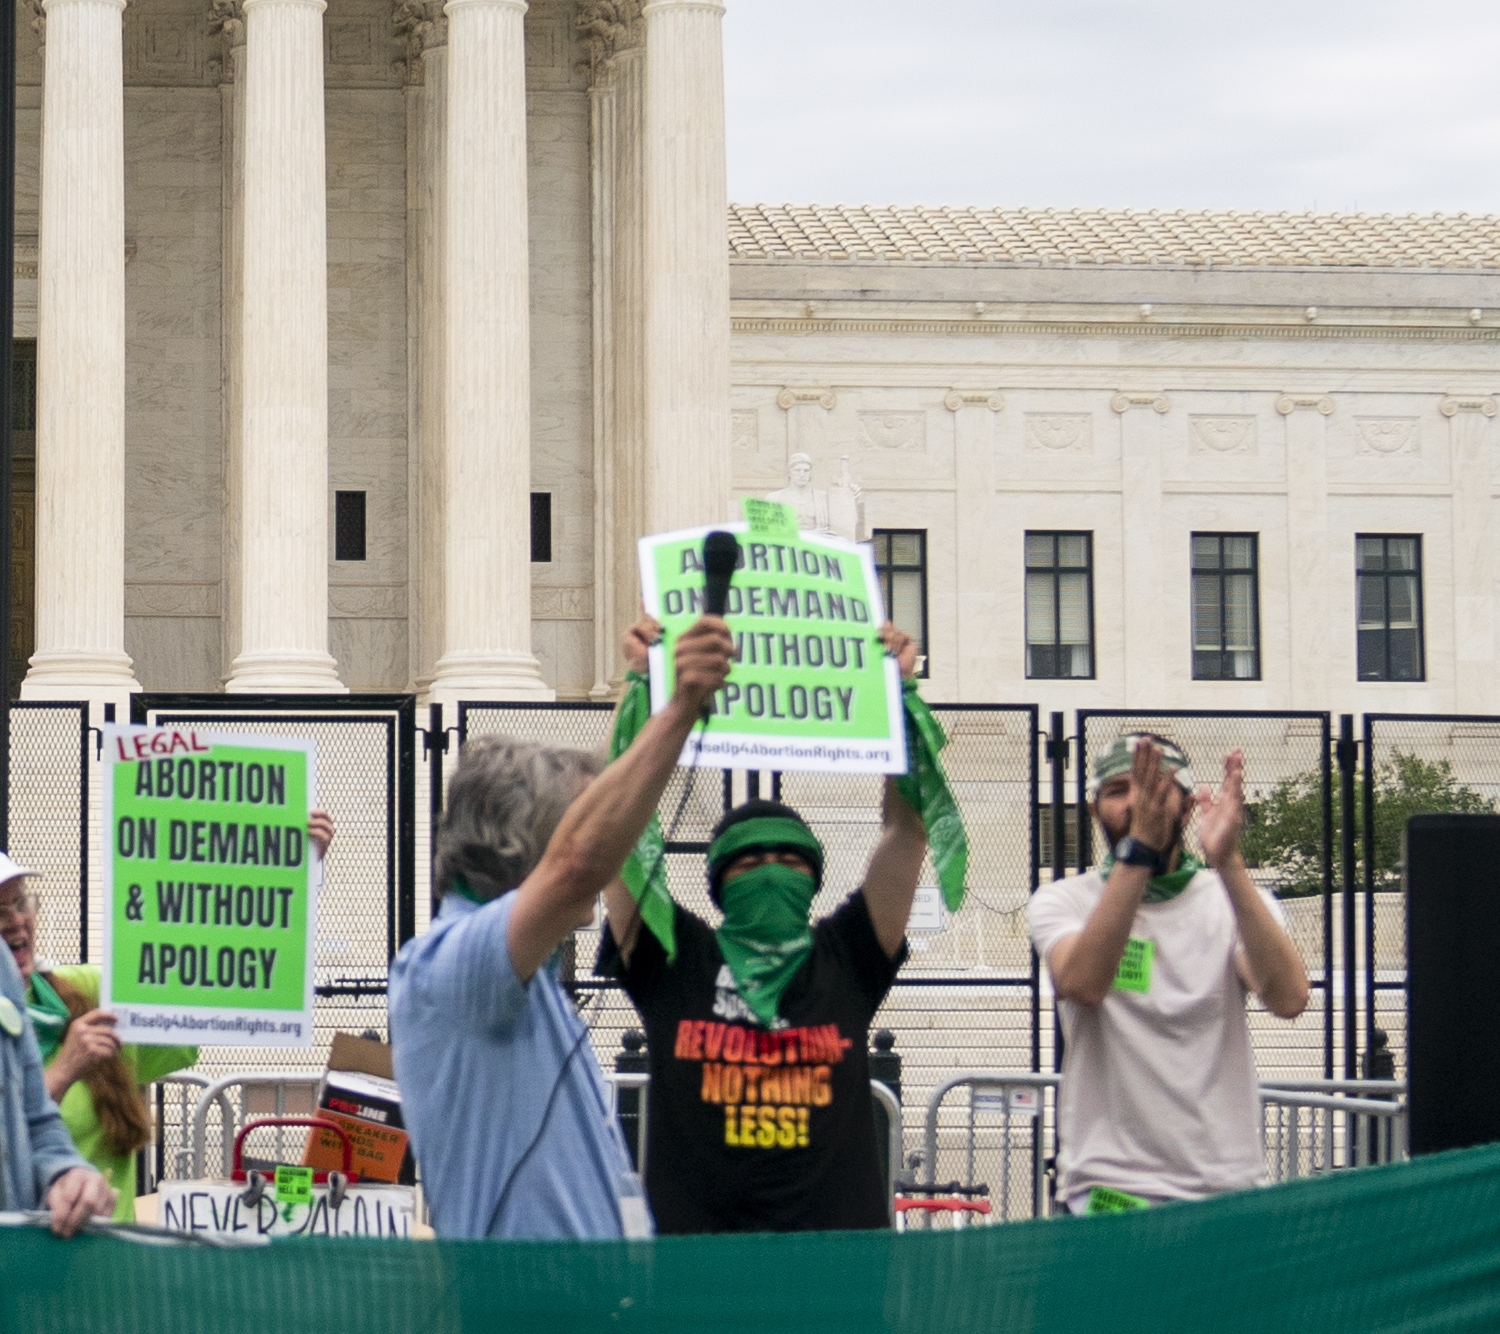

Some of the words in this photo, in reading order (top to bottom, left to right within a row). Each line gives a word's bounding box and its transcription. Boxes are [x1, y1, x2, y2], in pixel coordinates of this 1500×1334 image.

[680, 542, 843, 582] AORTION
[725, 585, 869, 623] DEMAND
[116, 731, 209, 762] LEGAL
[134, 757, 286, 805] ABORTION
[117, 817, 157, 858] ON
[169, 820, 303, 867] DEMAND
[126, 884, 145, 922] &
[156, 881, 294, 929] WITHOUT
[138, 942, 278, 990] APOLOGY
[700, 1062, 833, 1107] NOTHING
[725, 1105, 810, 1148] LESS!
